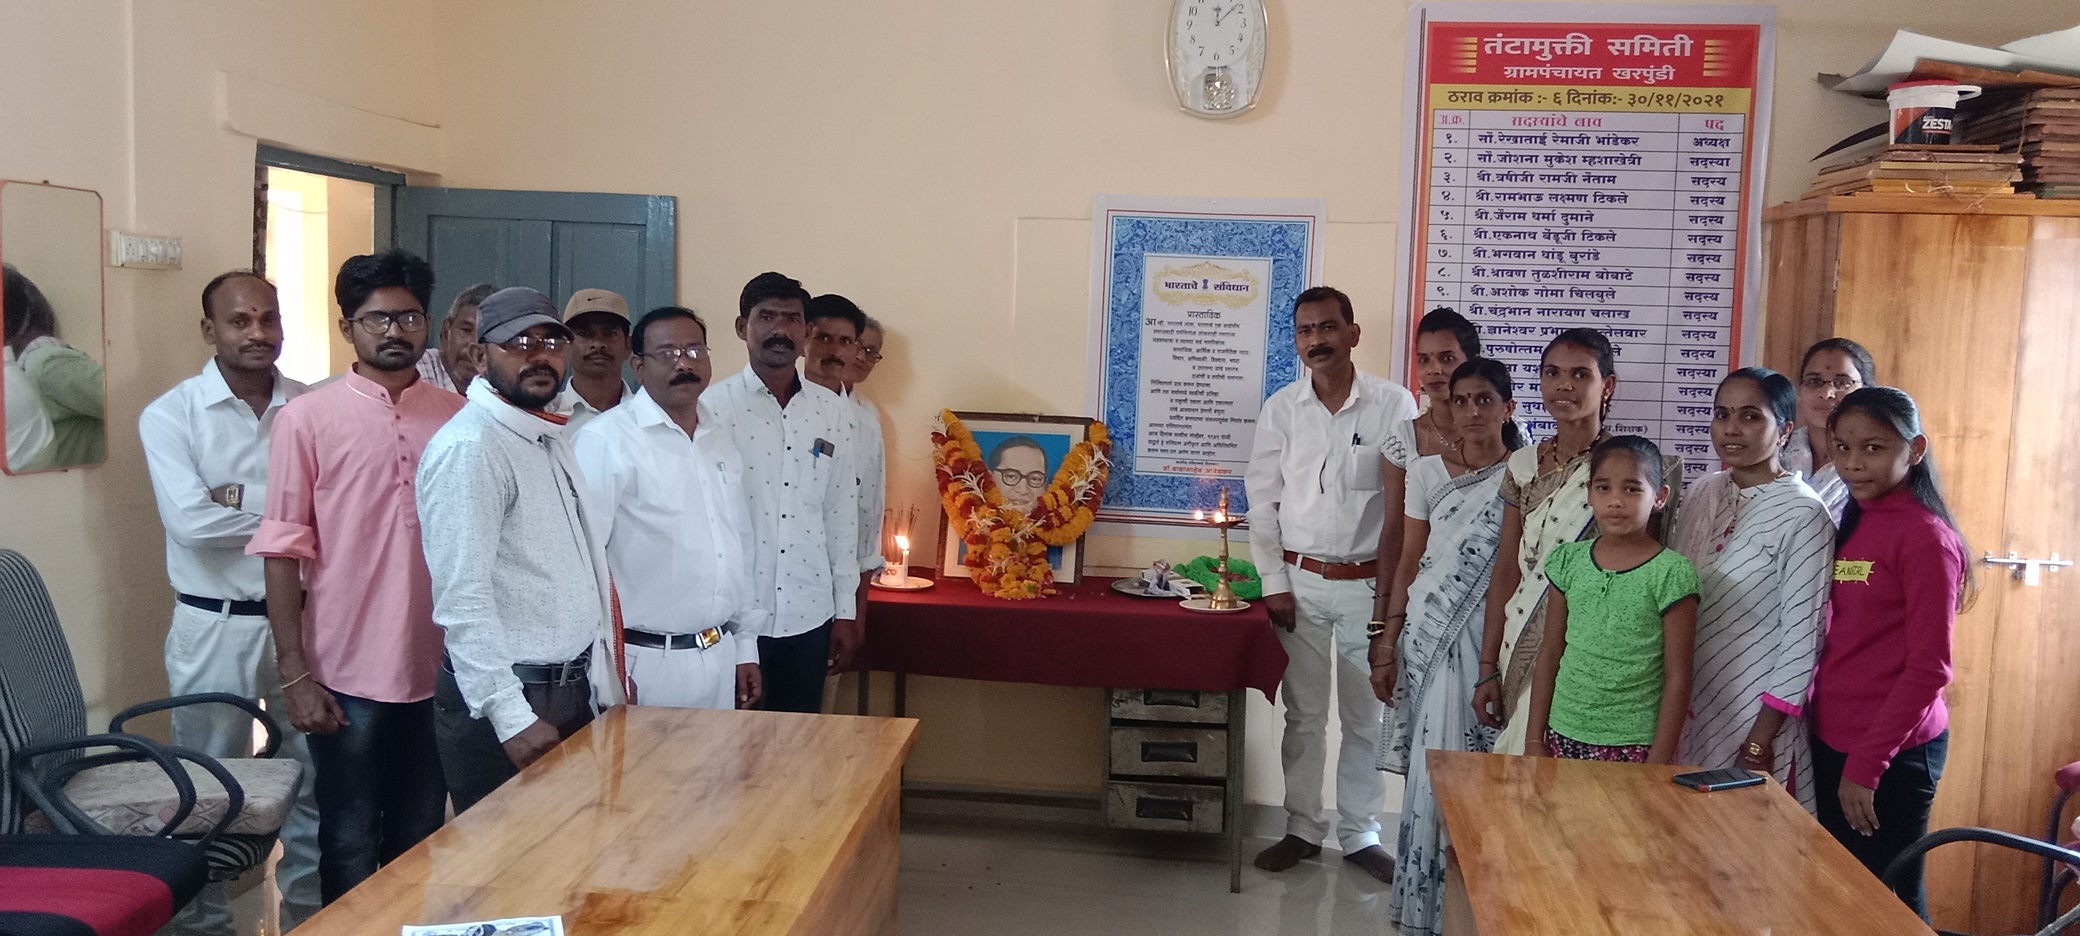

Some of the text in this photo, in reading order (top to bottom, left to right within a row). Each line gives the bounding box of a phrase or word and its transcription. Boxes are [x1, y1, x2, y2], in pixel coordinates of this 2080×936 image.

[1188, 6, 1198, 16] 10
[1238, 3, 1244, 14] 2
[1186, 20, 1193, 30] 9
[1240, 18, 1247, 29] 3
[1189, 35, 1196, 45] 8
[1198, 46, 1205, 57] 7
[1229, 45, 1235, 55] 5
[1483, 32, 1694, 62] तंटामुक्ती समिती
[1213, 51, 1220, 61] 6
[1503, 63, 1676, 85] ग्रामपंचायत खरपुंडी
[1447, 90, 1484, 104] ठराव
[1488, 88, 1534, 104] क्रमांक
[1552, 91, 1562, 106] ६
[1627, 91, 1725, 109] ३०/११/२०२१
[1704, 119, 1725, 131] पद
[1552, 133, 1591, 146] रेमाजी
[1596, 133, 1640, 147] भांडेकर
[1692, 136, 1731, 149] अध्यक्ष
[1544, 151, 1578, 168] मुकेश
[1689, 156, 1731, 169] सदस्या
[1539, 171, 1578, 184] रामजी
[1582, 171, 1617, 185] नैताम
[1691, 176, 1728, 189] सदस्य
[1548, 192, 1588, 204] लक्ष्मण
[1593, 190, 1629, 205] टिकले
[1690, 195, 1726, 208] सदस्य
[1531, 209, 1557, 222] धर्मा
[1561, 209, 1595, 226] दुमाने
[1688, 214, 1725, 227] सदस्य
[1581, 229, 1617, 243] टिकले
[1687, 234, 1724, 247] सदस्य
[1686, 253, 1723, 266] सदस्य
[1531, 266, 1591, 283] तुळशीराम
[1595, 267, 1634, 282] बोबाटे
[1685, 272, 1721, 285] सदस्य
[1164, 280, 1250, 292] भारताचे संविधान
[1534, 285, 1565, 299] गोमा
[1684, 291, 1720, 304] सदस्य
[1536, 306, 1586, 319] नारायण
[1590, 308, 1631, 320] चलाख
[1682, 310, 1719, 323] सदस्य
[1681, 329, 1718, 342] सदस्य
[1680, 348, 1716, 361] सदस्य
[1676, 367, 1718, 380] सदस्या
[1678, 386, 1714, 399] सदस्य
[1676, 405, 1713, 418] सदस्य
[1675, 424, 1711, 437] सदस्य
[1674, 443, 1710, 456] सदस्य
[1683, 462, 1709, 475] दस्य
